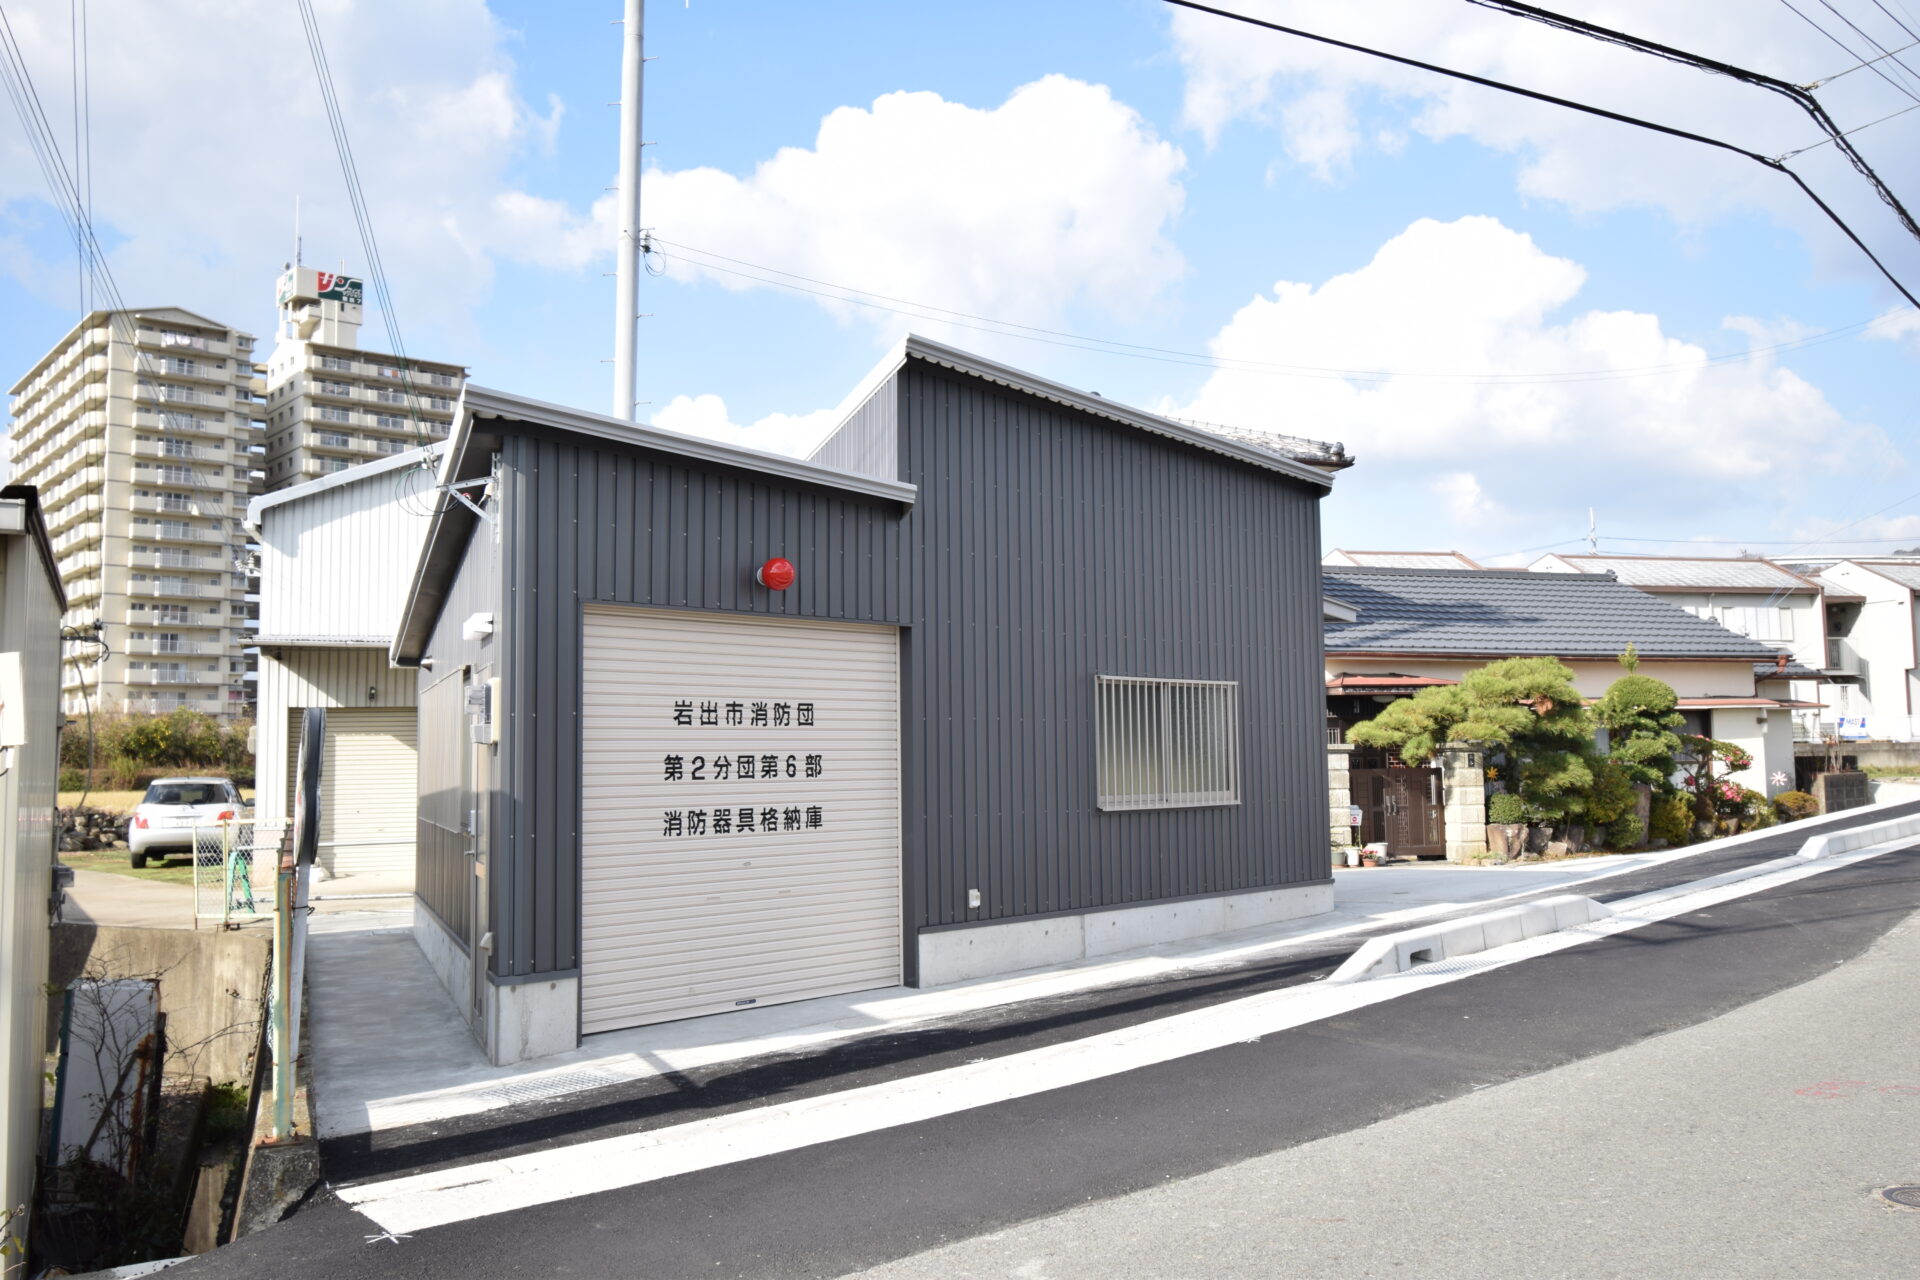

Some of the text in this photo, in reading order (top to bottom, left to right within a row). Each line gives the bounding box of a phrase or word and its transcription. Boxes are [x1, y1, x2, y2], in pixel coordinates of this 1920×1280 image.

[673, 700, 814, 727] 岩出市消防団
[663, 754, 822, 781] 第2分団第6部
[663, 805, 823, 837] 消防器具格納庫
